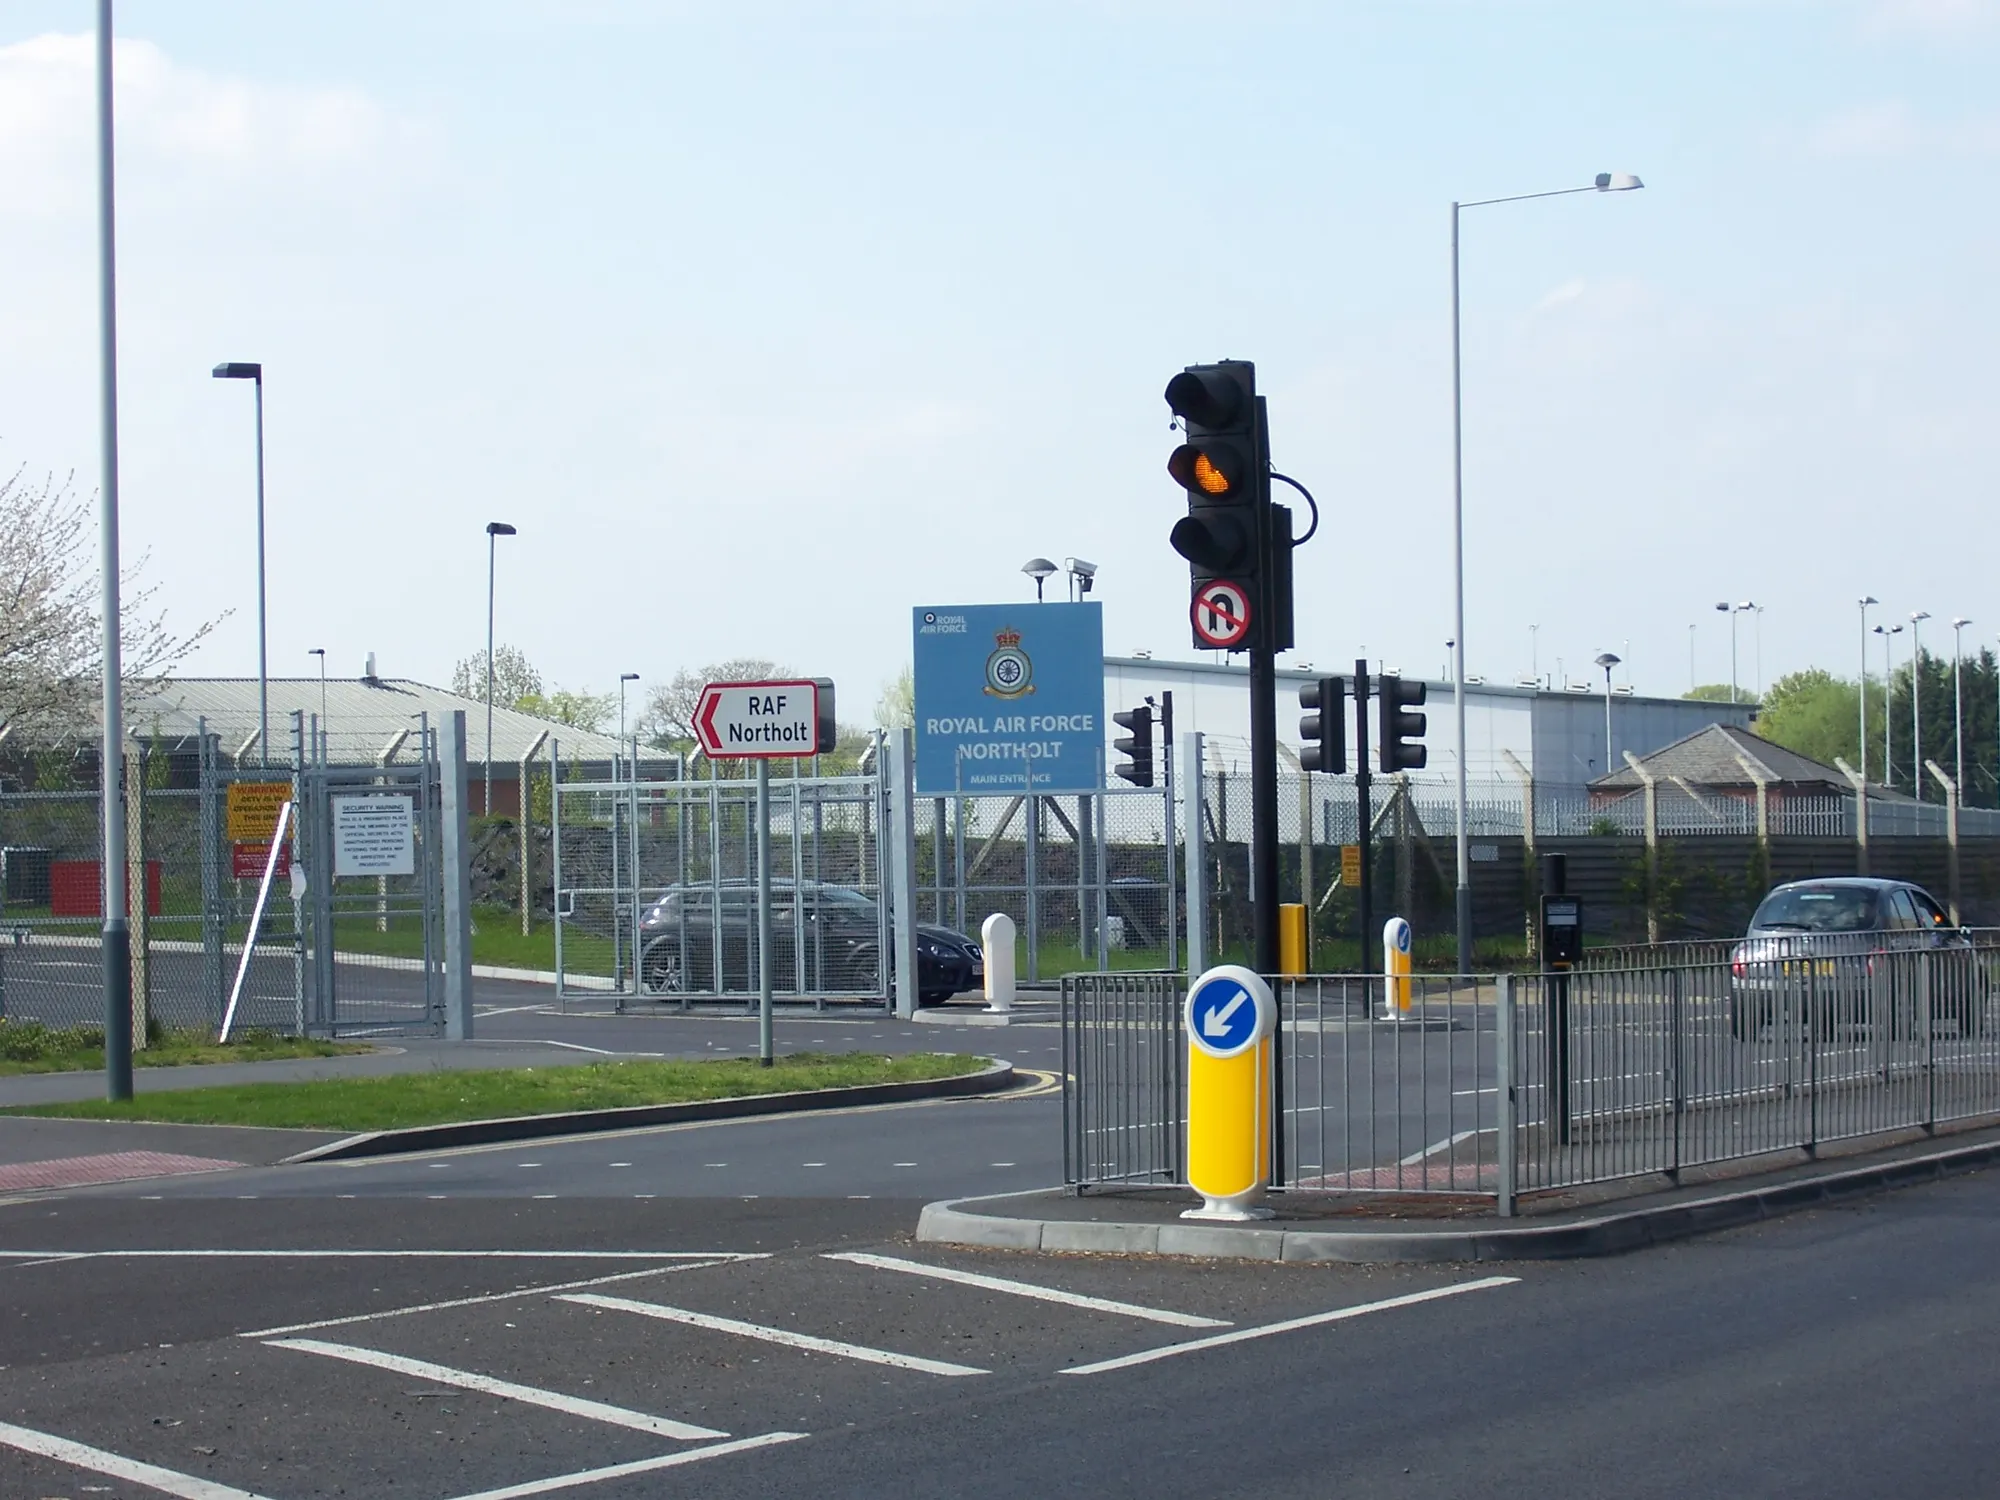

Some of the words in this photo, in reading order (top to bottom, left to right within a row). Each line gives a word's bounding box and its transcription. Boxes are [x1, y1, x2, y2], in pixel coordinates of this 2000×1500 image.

[920, 625, 937, 634] AIR
[937, 624, 967, 633] FORCE
[937, 616, 967, 624] ROYAL
[749, 696, 787, 716] RAF
[729, 722, 808, 742] Northolt
[927, 718, 988, 735] ROYAL
[993, 717, 1026, 733] AIR
[1030, 715, 1093, 732] FORCE
[959, 742, 1063, 760] NORTHOLT
[970, 775, 997, 784] MAIN
